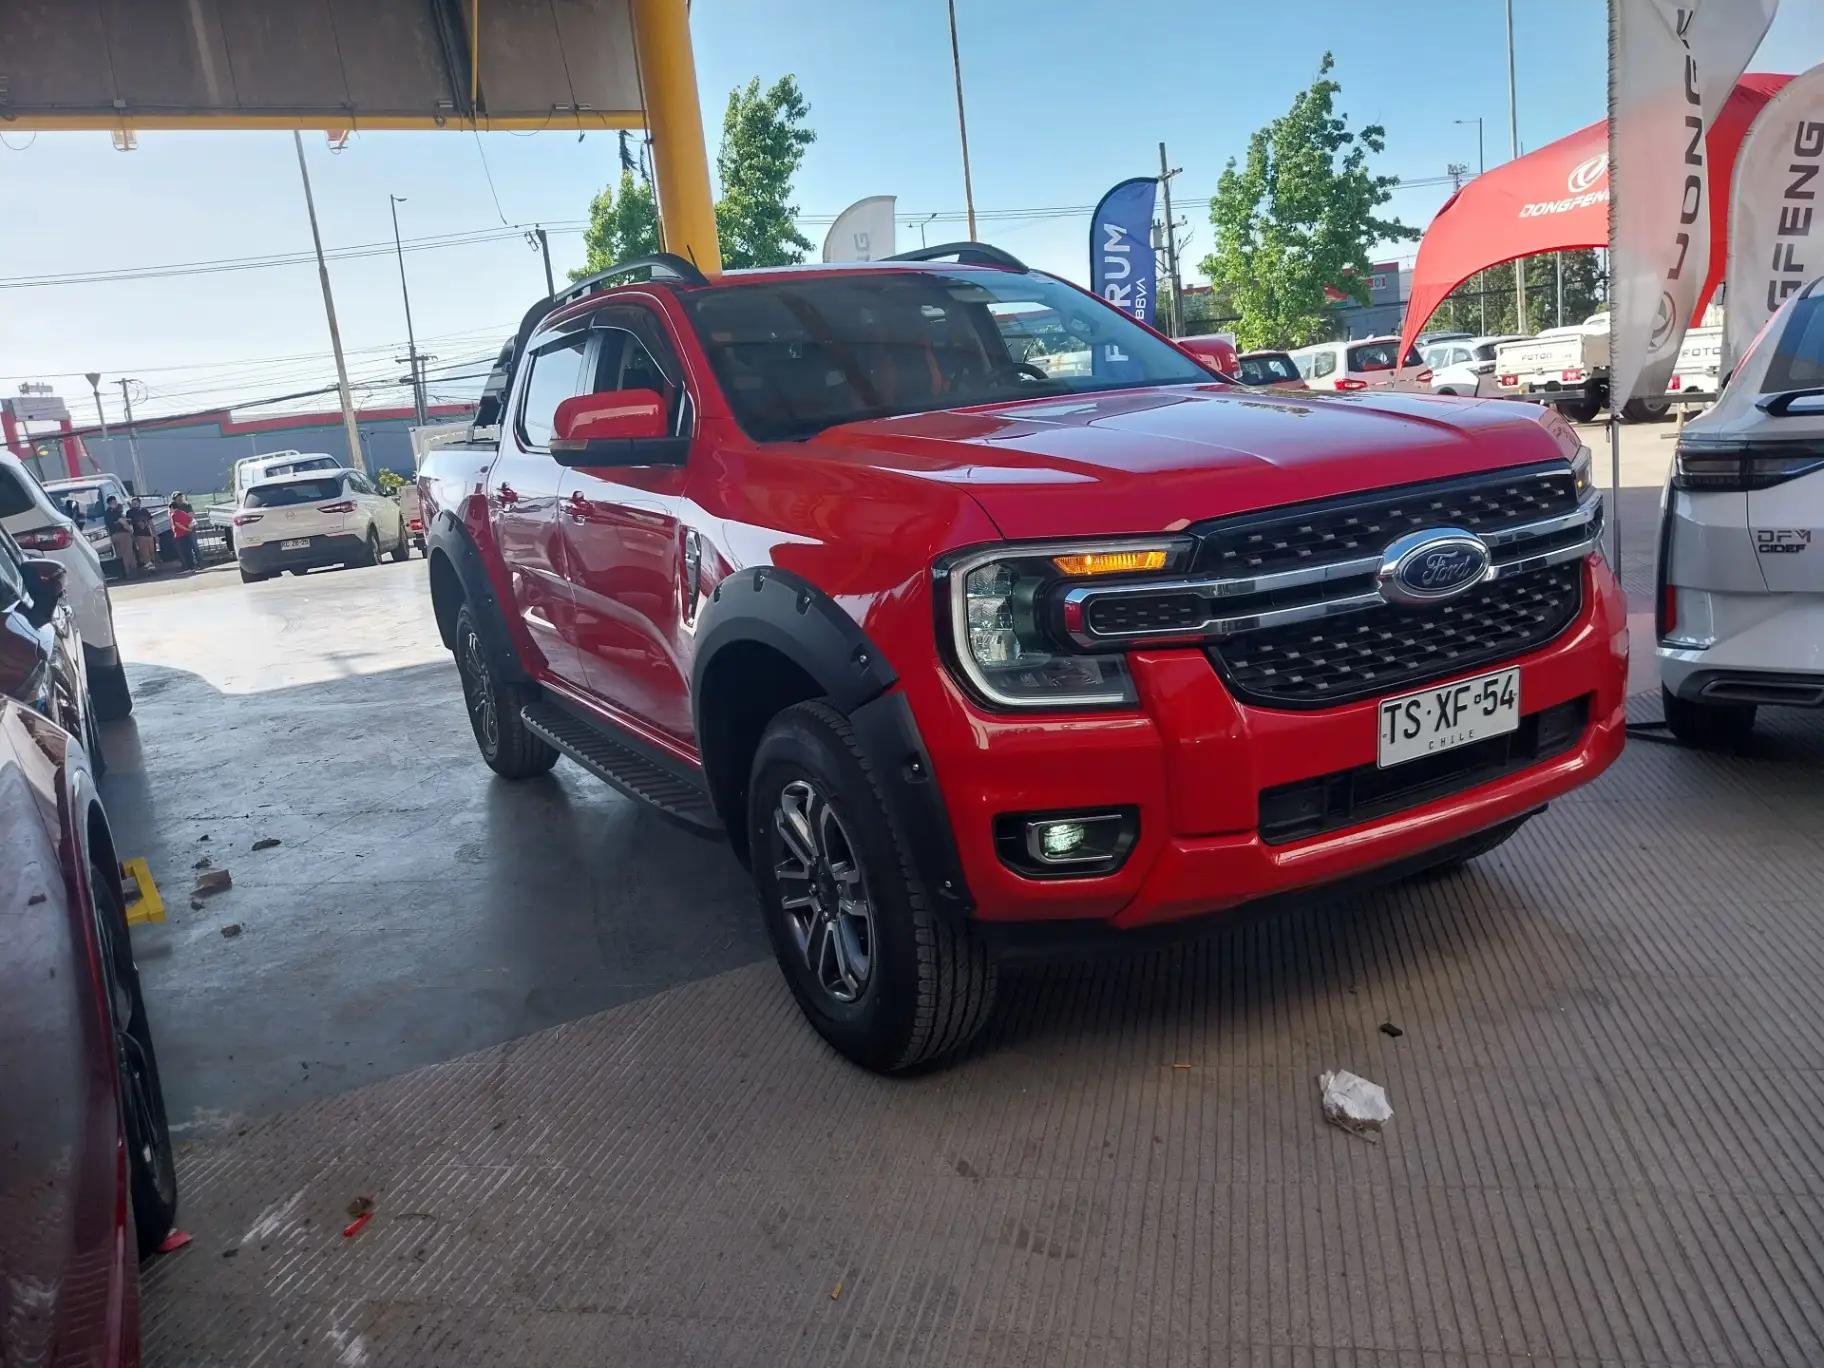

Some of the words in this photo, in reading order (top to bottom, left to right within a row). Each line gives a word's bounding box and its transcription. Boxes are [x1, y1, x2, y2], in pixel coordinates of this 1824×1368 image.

[1135, 277, 1147, 320] BBVA
[1757, 528, 1811, 543] DFM
[1758, 544, 1806, 553] CIDEF
[1422, 551, 1471, 585] Ford
[1428, 728, 1475, 750] CHILE
